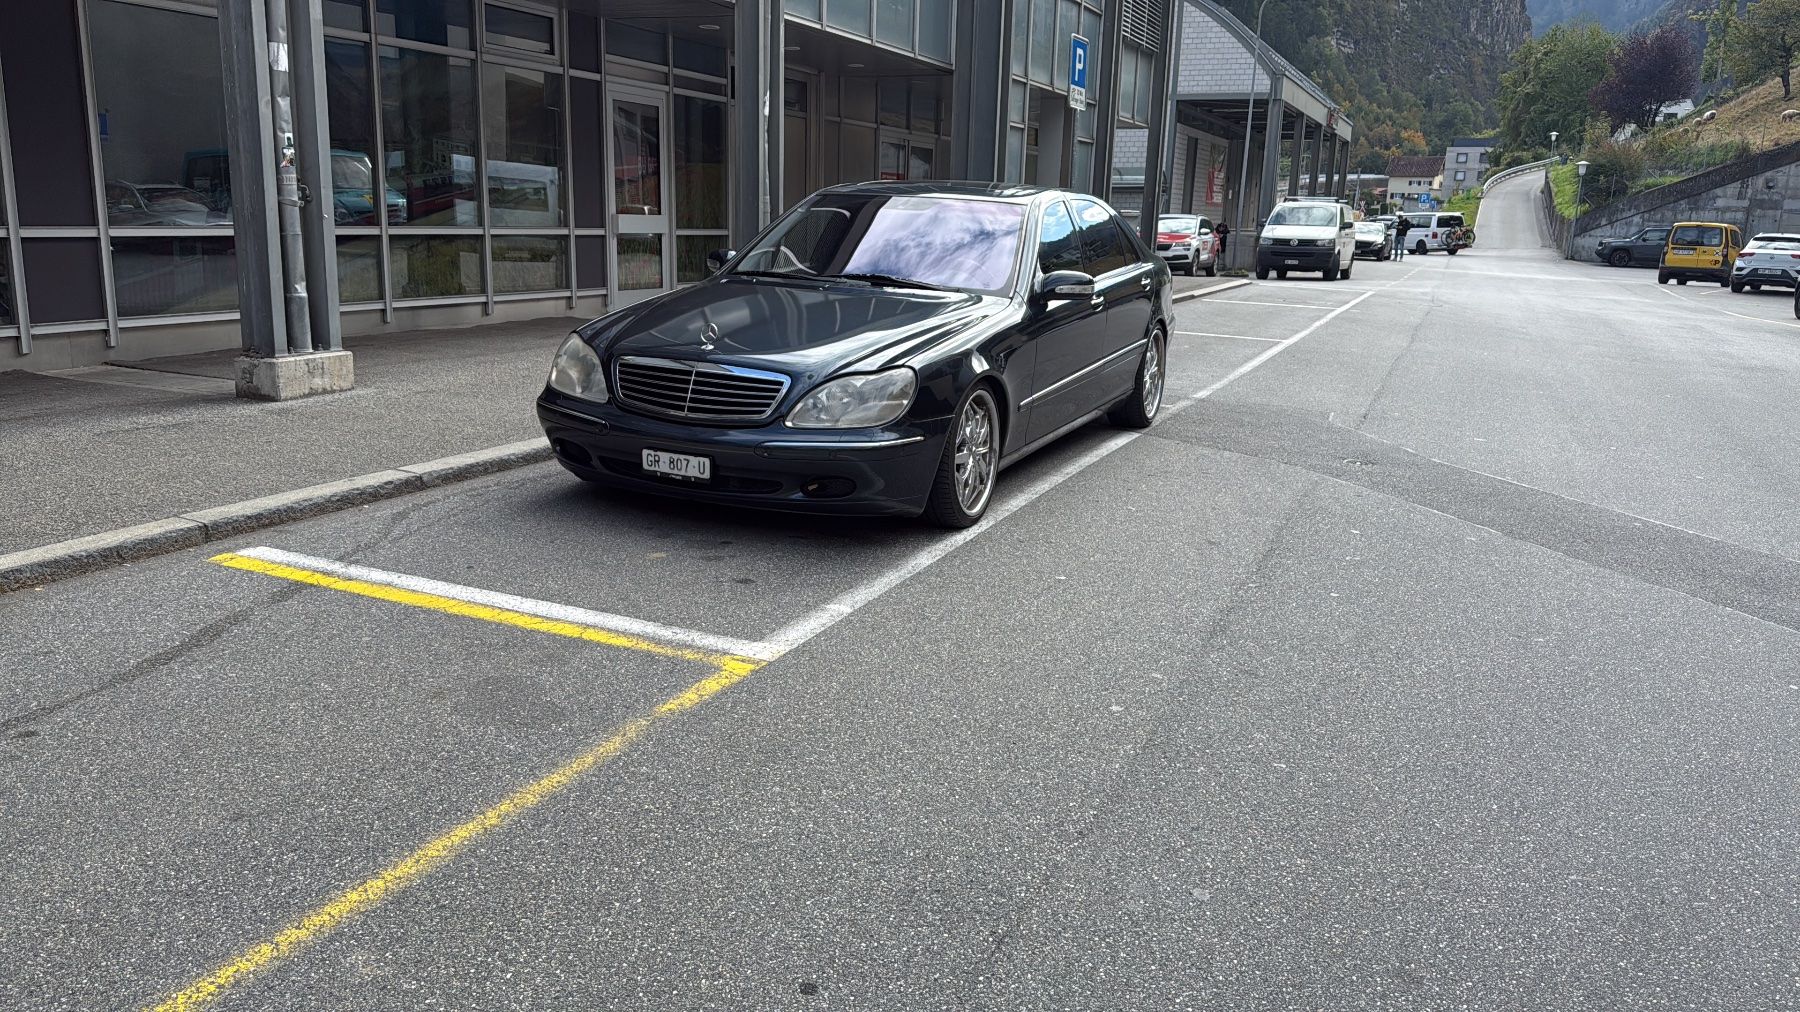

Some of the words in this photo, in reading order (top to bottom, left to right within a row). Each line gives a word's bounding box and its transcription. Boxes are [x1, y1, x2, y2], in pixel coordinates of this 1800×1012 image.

[1075, 47, 1084, 81] P
[646, 453, 660, 469] GR
[669, 456, 690, 473] 807
[698, 460, 706, 475] U
